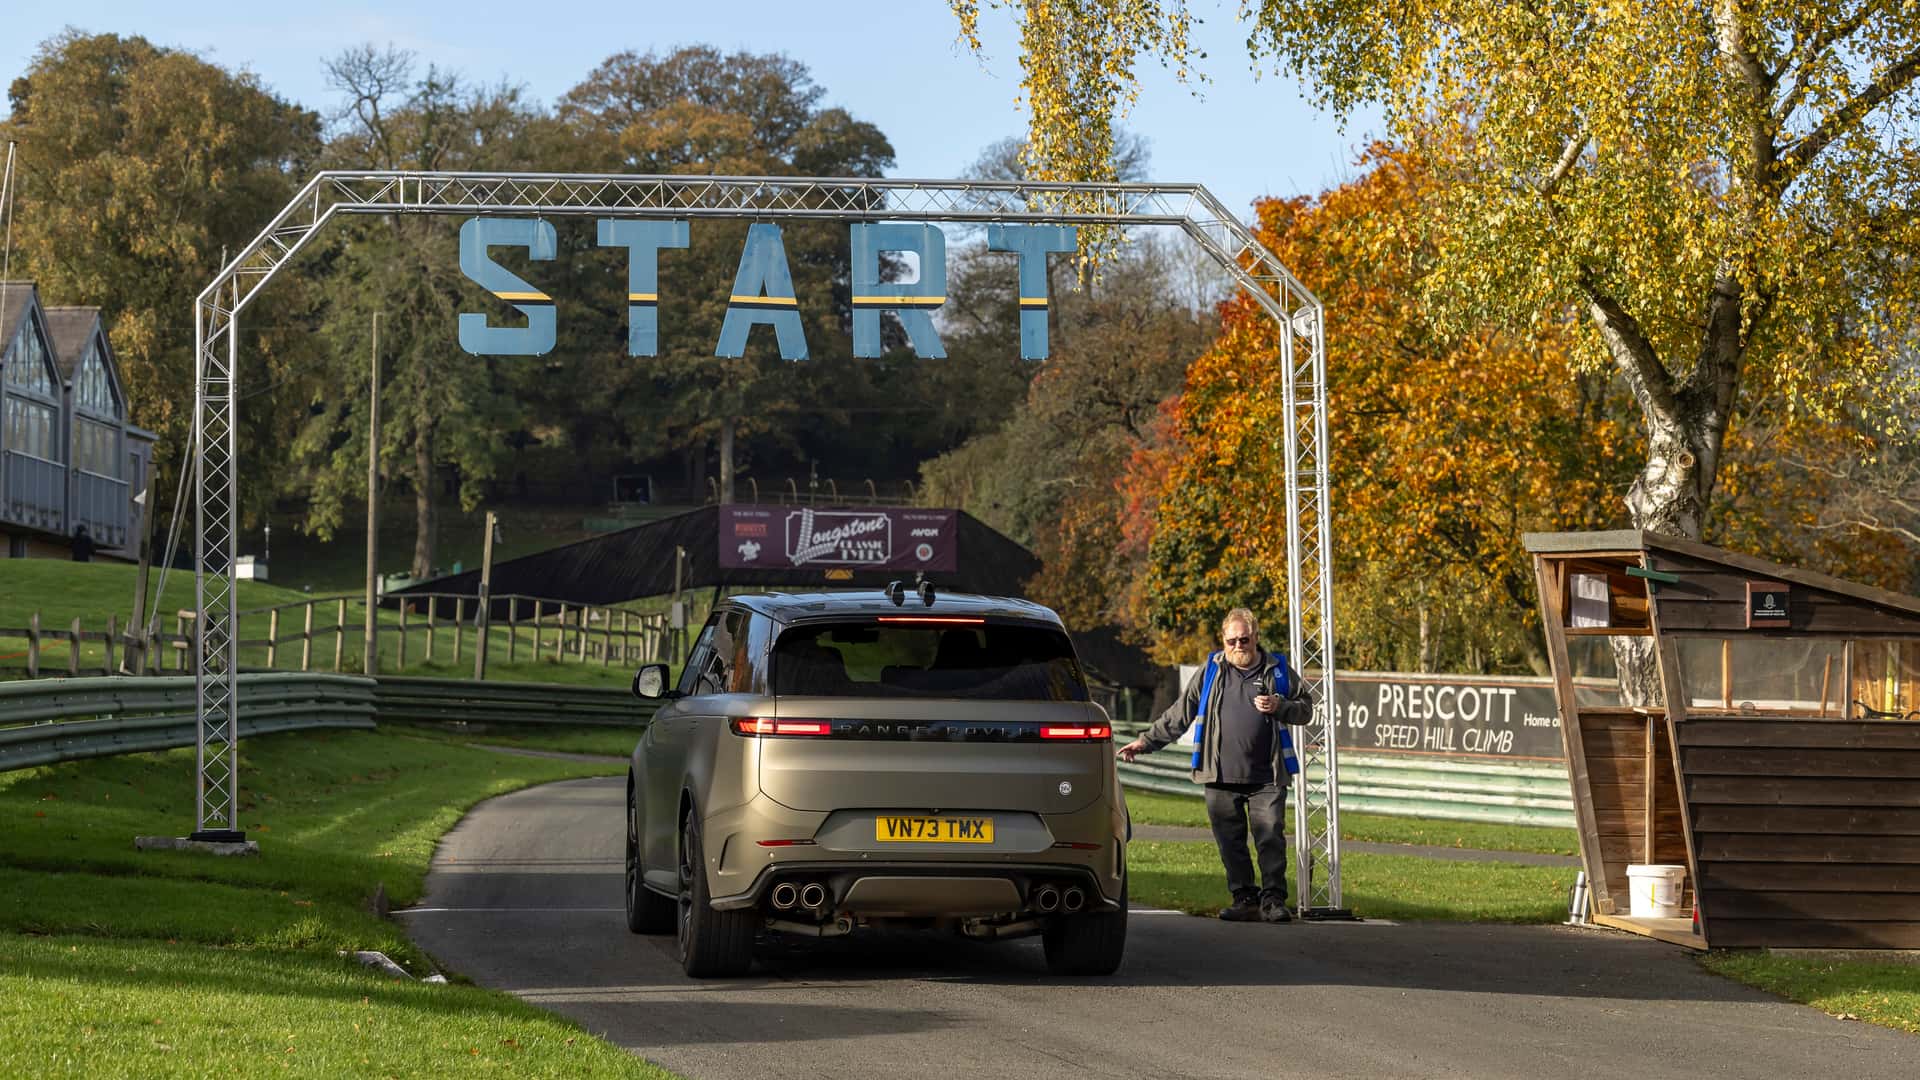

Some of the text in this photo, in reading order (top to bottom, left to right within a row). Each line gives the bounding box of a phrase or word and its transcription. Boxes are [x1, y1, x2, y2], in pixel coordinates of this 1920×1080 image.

[459, 217, 1078, 361] START
[790, 508, 886, 566] Longstone
[1348, 701, 1369, 729] to
[1377, 683, 1517, 723] PRESCOTT
[1523, 713, 1561, 728] Home o
[1374, 723, 1514, 753] SPEED HILL CLIMB
[886, 818, 984, 839] VN73 TMX
